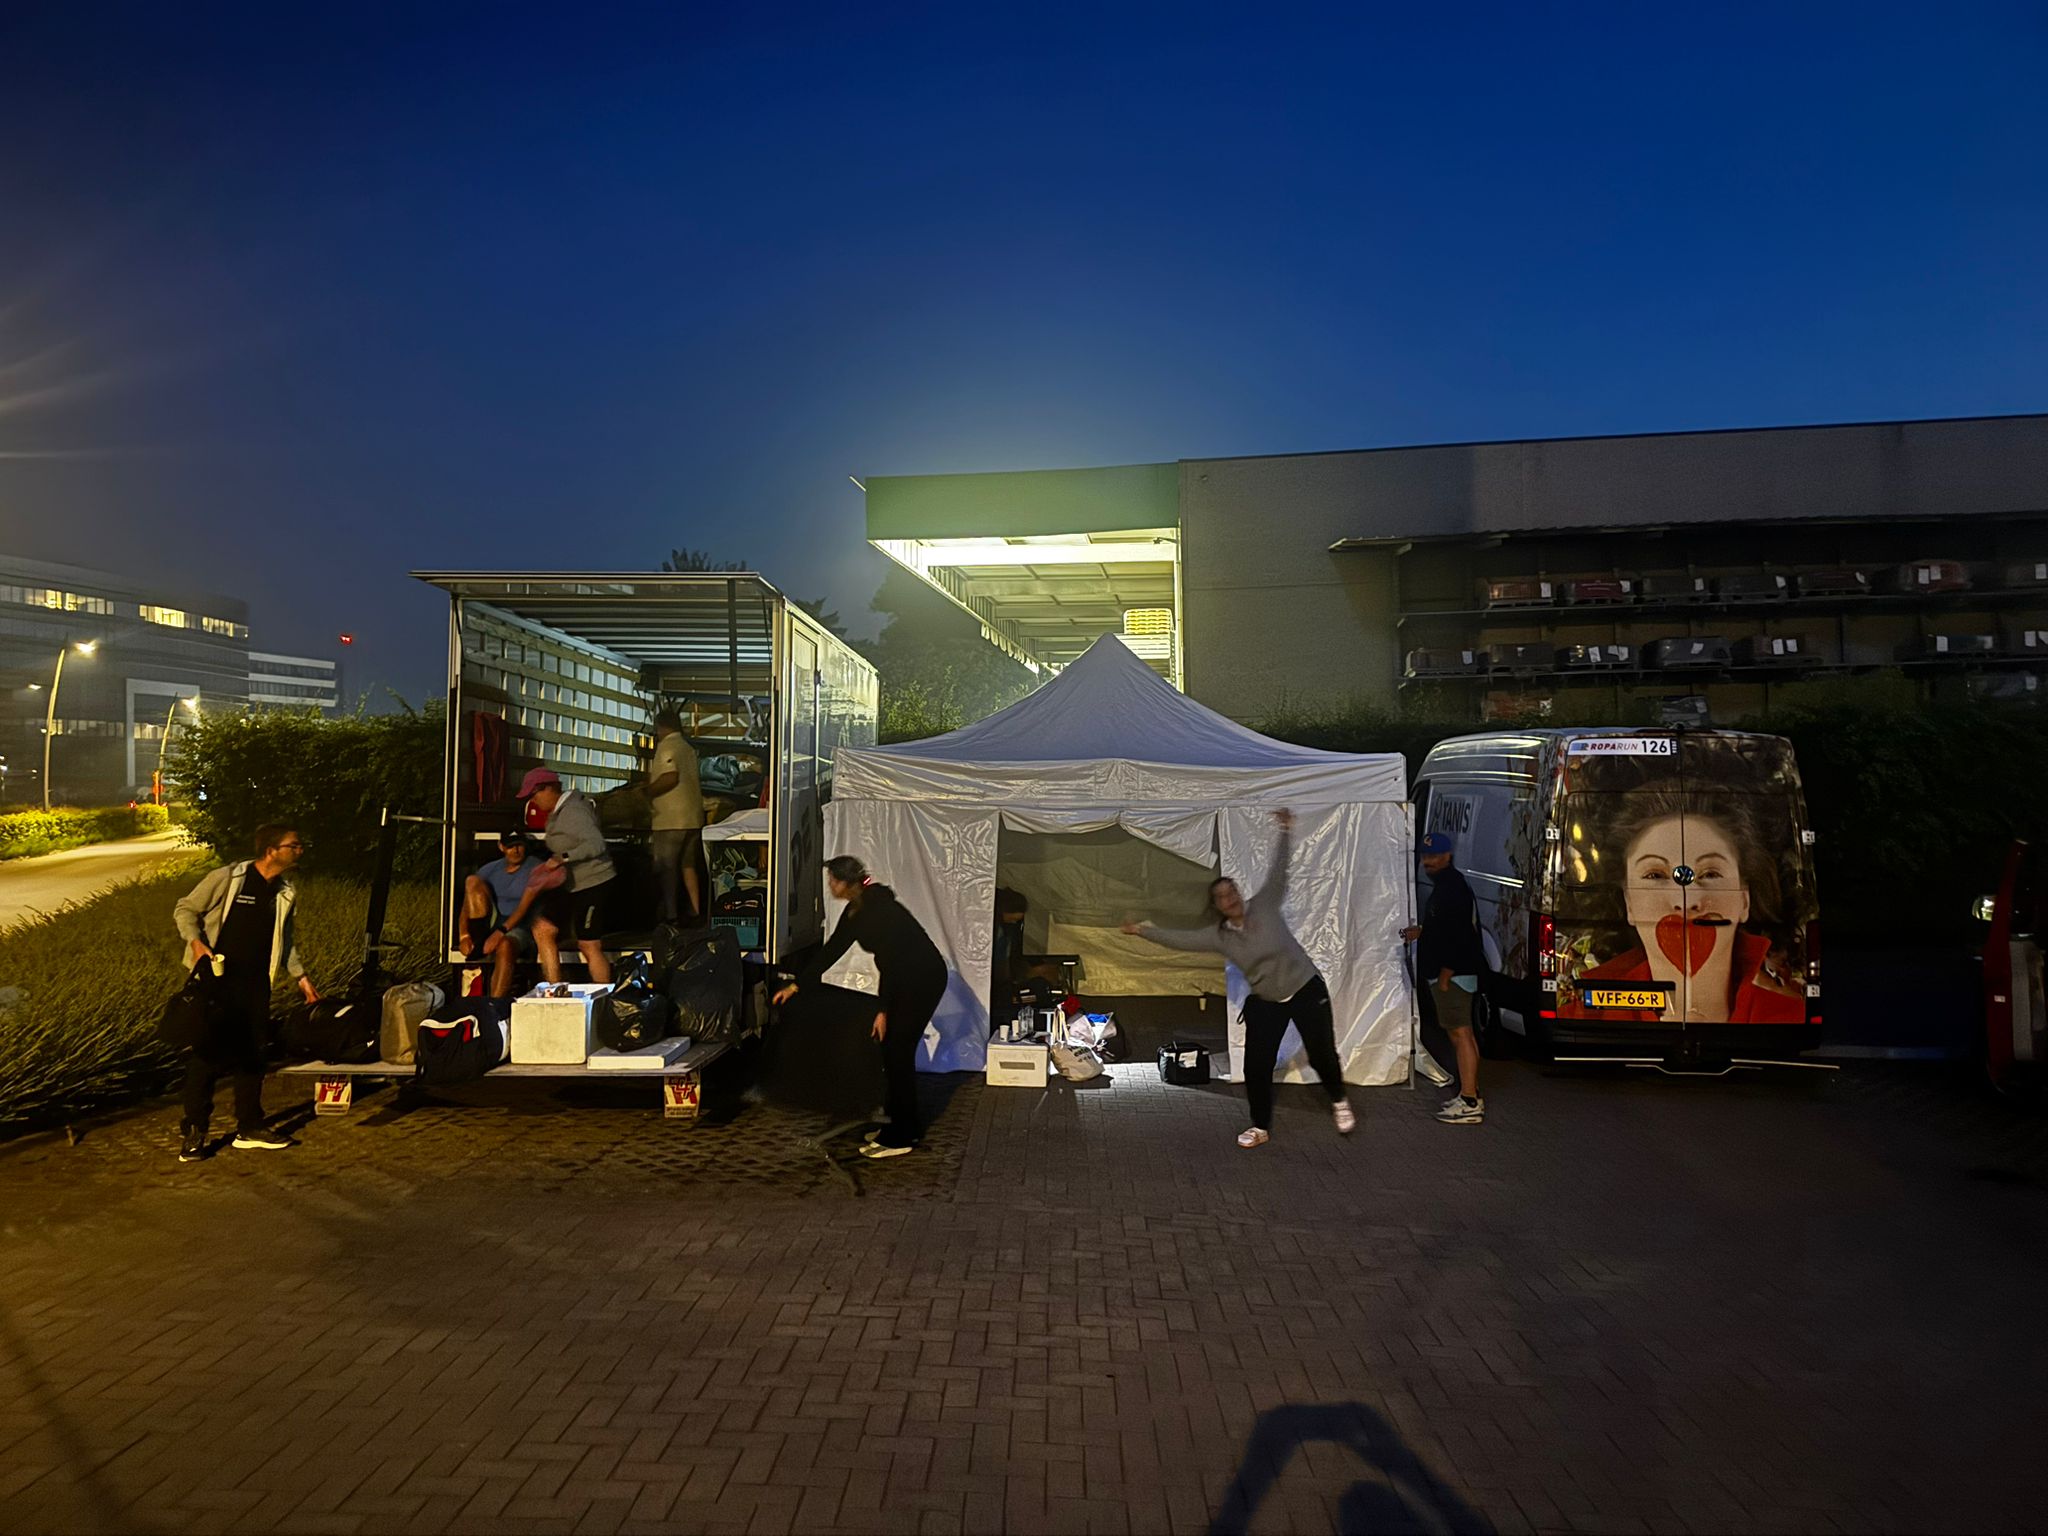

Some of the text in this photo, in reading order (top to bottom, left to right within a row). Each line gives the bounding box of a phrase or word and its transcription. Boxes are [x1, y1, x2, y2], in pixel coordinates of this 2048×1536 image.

[1590, 743, 1638, 751] ROPARUN
[1641, 740, 1668, 753] 126
[1597, 991, 1659, 1006] VFF-66-R
